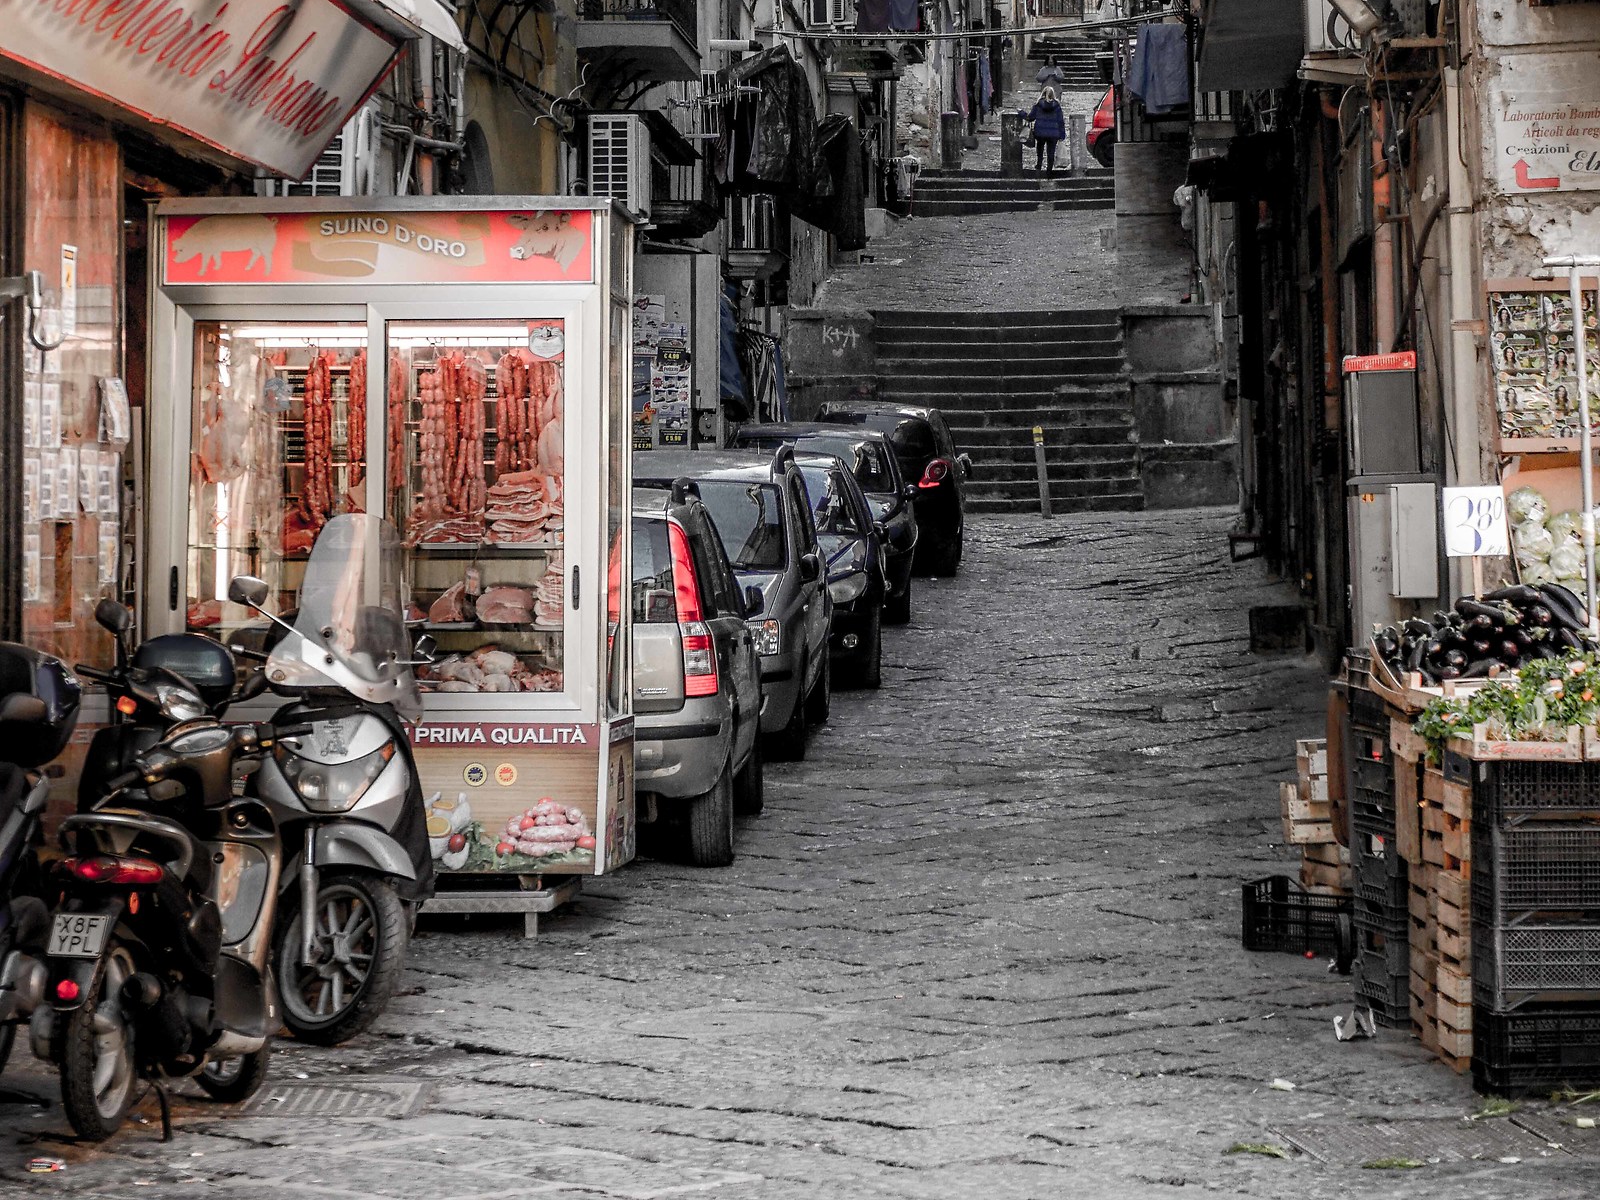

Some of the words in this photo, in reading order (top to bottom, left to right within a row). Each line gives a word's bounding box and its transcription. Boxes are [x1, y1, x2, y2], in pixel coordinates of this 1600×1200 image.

[208, 4, 341, 137] Lubrano
[1503, 108, 1566, 122] Laboratorio
[1522, 125, 1564, 138] Articoli
[1566, 126, 1579, 137] da
[1505, 143, 1570, 156] Creazioni
[320, 217, 389, 236] SUINO
[395, 224, 466, 258] D'ORO
[415, 727, 487, 743] PRIMA
[490, 725, 587, 746] QUALITÀ
[60, 916, 100, 934] X8F
[57, 936, 93, 953] YPL
